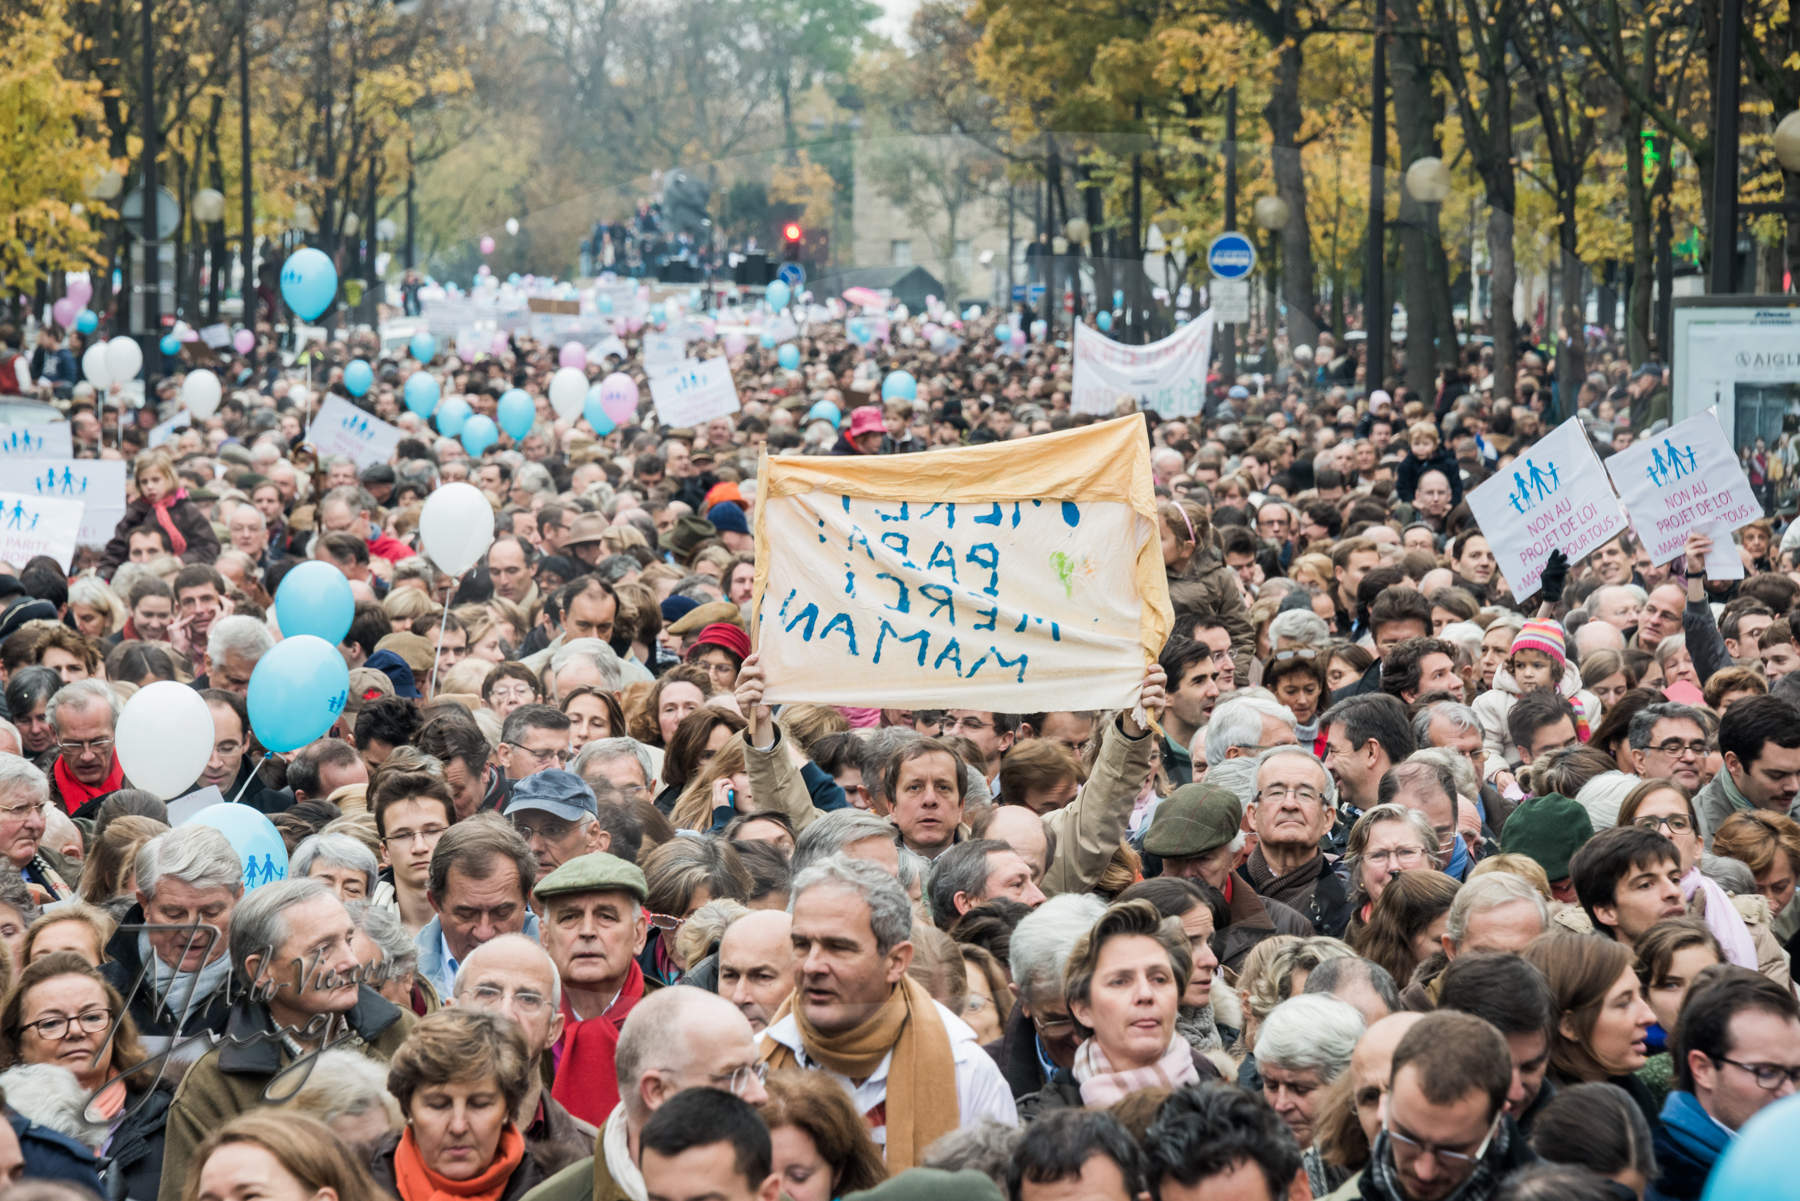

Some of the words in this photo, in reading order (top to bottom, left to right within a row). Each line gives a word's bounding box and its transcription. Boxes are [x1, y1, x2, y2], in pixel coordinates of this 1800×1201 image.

[1656, 507, 1695, 535] PROJET
[1696, 498, 1714, 517] DE
[1713, 490, 1733, 509] LOI
[1664, 486, 1691, 511] NON
[1692, 479, 1708, 501] AU
[1519, 528, 1561, 567] PROJET
[1560, 515, 1579, 537] DE
[1577, 502, 1598, 526] LOI
[1527, 511, 1555, 537] NON
[1555, 497, 1572, 519] AU
